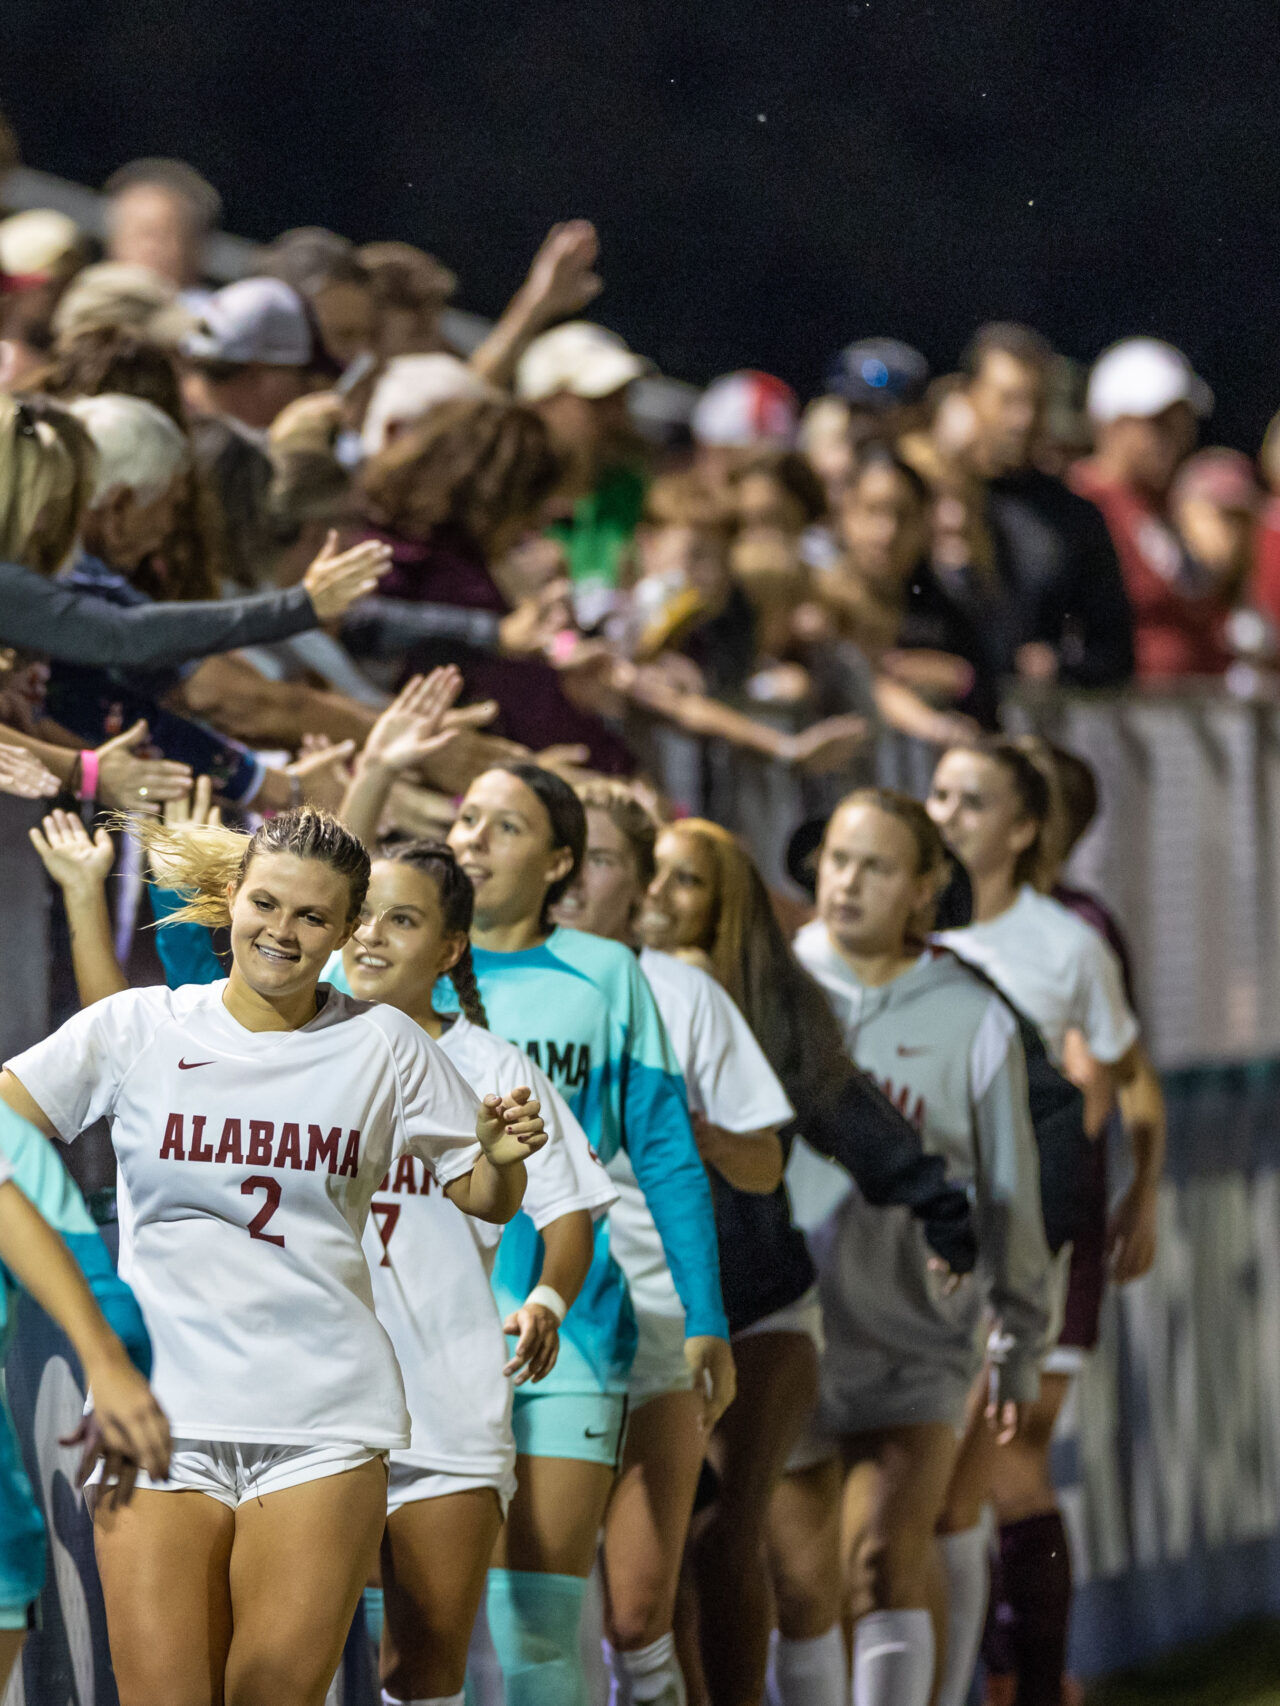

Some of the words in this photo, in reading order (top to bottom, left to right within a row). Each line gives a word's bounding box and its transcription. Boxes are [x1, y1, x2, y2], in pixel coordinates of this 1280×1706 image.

[508, 1040, 590, 1089] AMA
[159, 1112, 361, 1178] ALABAMA
[240, 1175, 286, 1249] 2
[371, 1203, 401, 1268] 7
